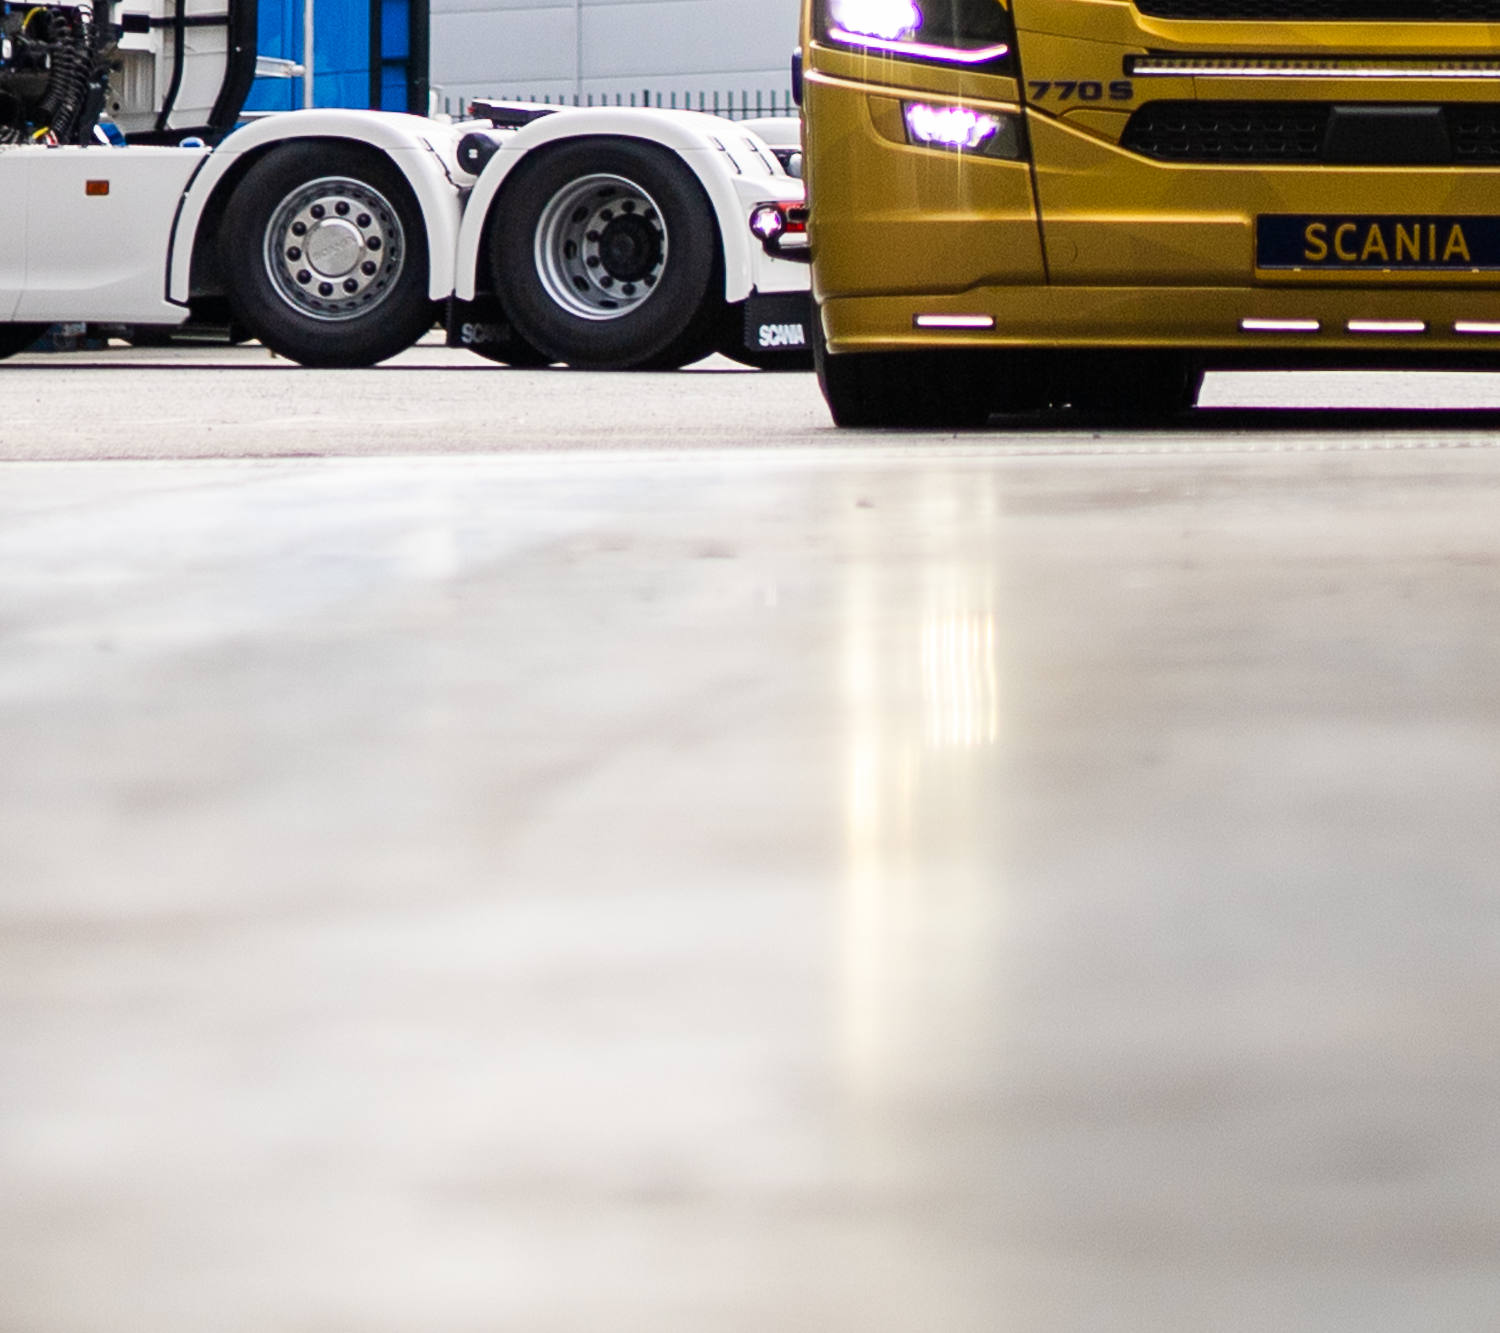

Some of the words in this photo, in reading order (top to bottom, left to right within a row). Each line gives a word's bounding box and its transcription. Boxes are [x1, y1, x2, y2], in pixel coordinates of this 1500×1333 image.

[1027, 80, 1103, 101] 770
[1108, 80, 1135, 101] S
[1303, 222, 1471, 262] SCANIA
[758, 323, 806, 346] SCANIA
